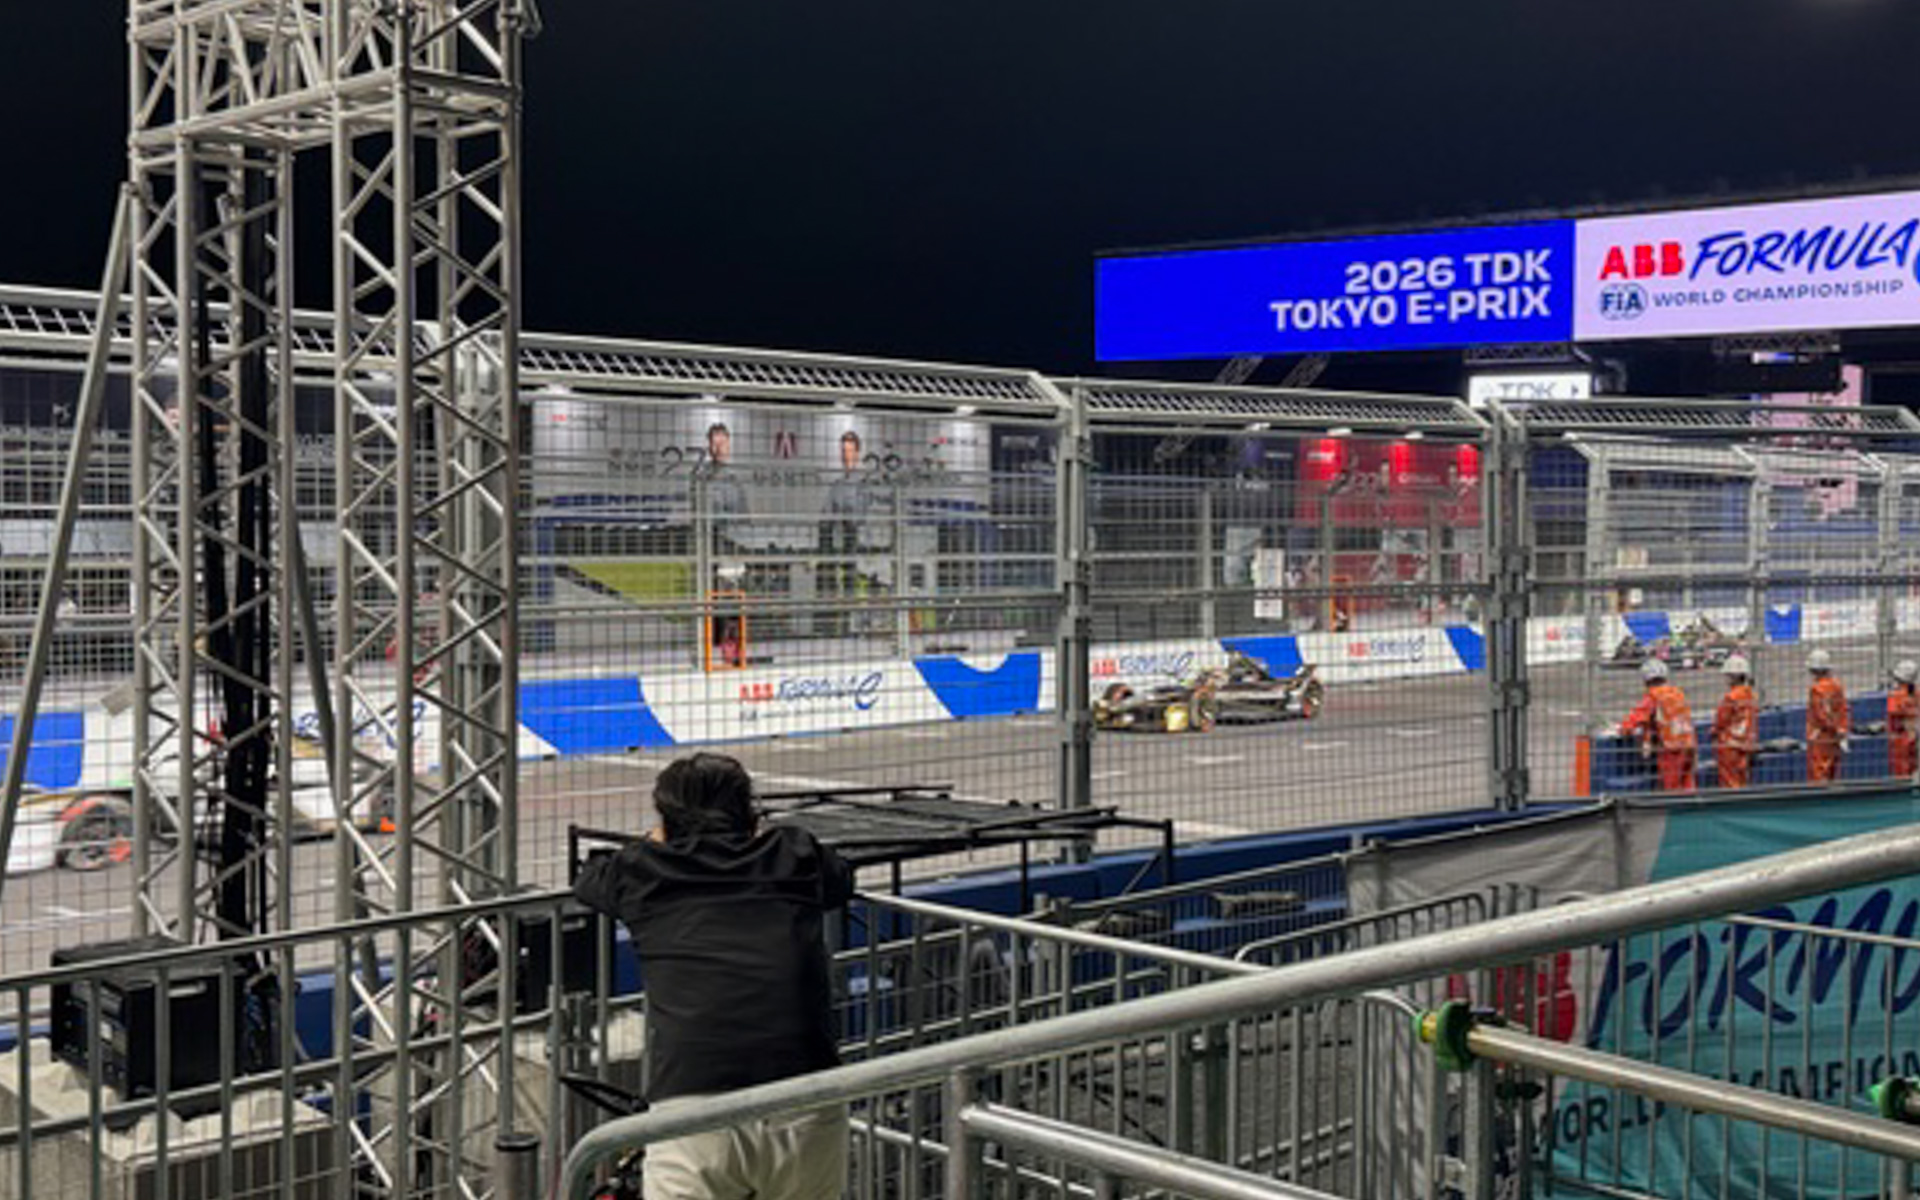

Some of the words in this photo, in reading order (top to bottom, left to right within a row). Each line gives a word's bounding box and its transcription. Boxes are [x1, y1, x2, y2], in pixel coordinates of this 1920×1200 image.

[1345, 257, 1456, 294] 2026
[1464, 249, 1552, 286] TDK
[1598, 241, 1685, 280] ABB
[1688, 218, 1920, 281] FORMULA
[1269, 295, 1398, 332] TOKYO
[1407, 284, 1552, 325] E-PRIX
[1653, 287, 1726, 307] WORLD
[1732, 279, 1904, 304] CHAMPIONSHIP
[1498, 382, 1558, 400] TDK
